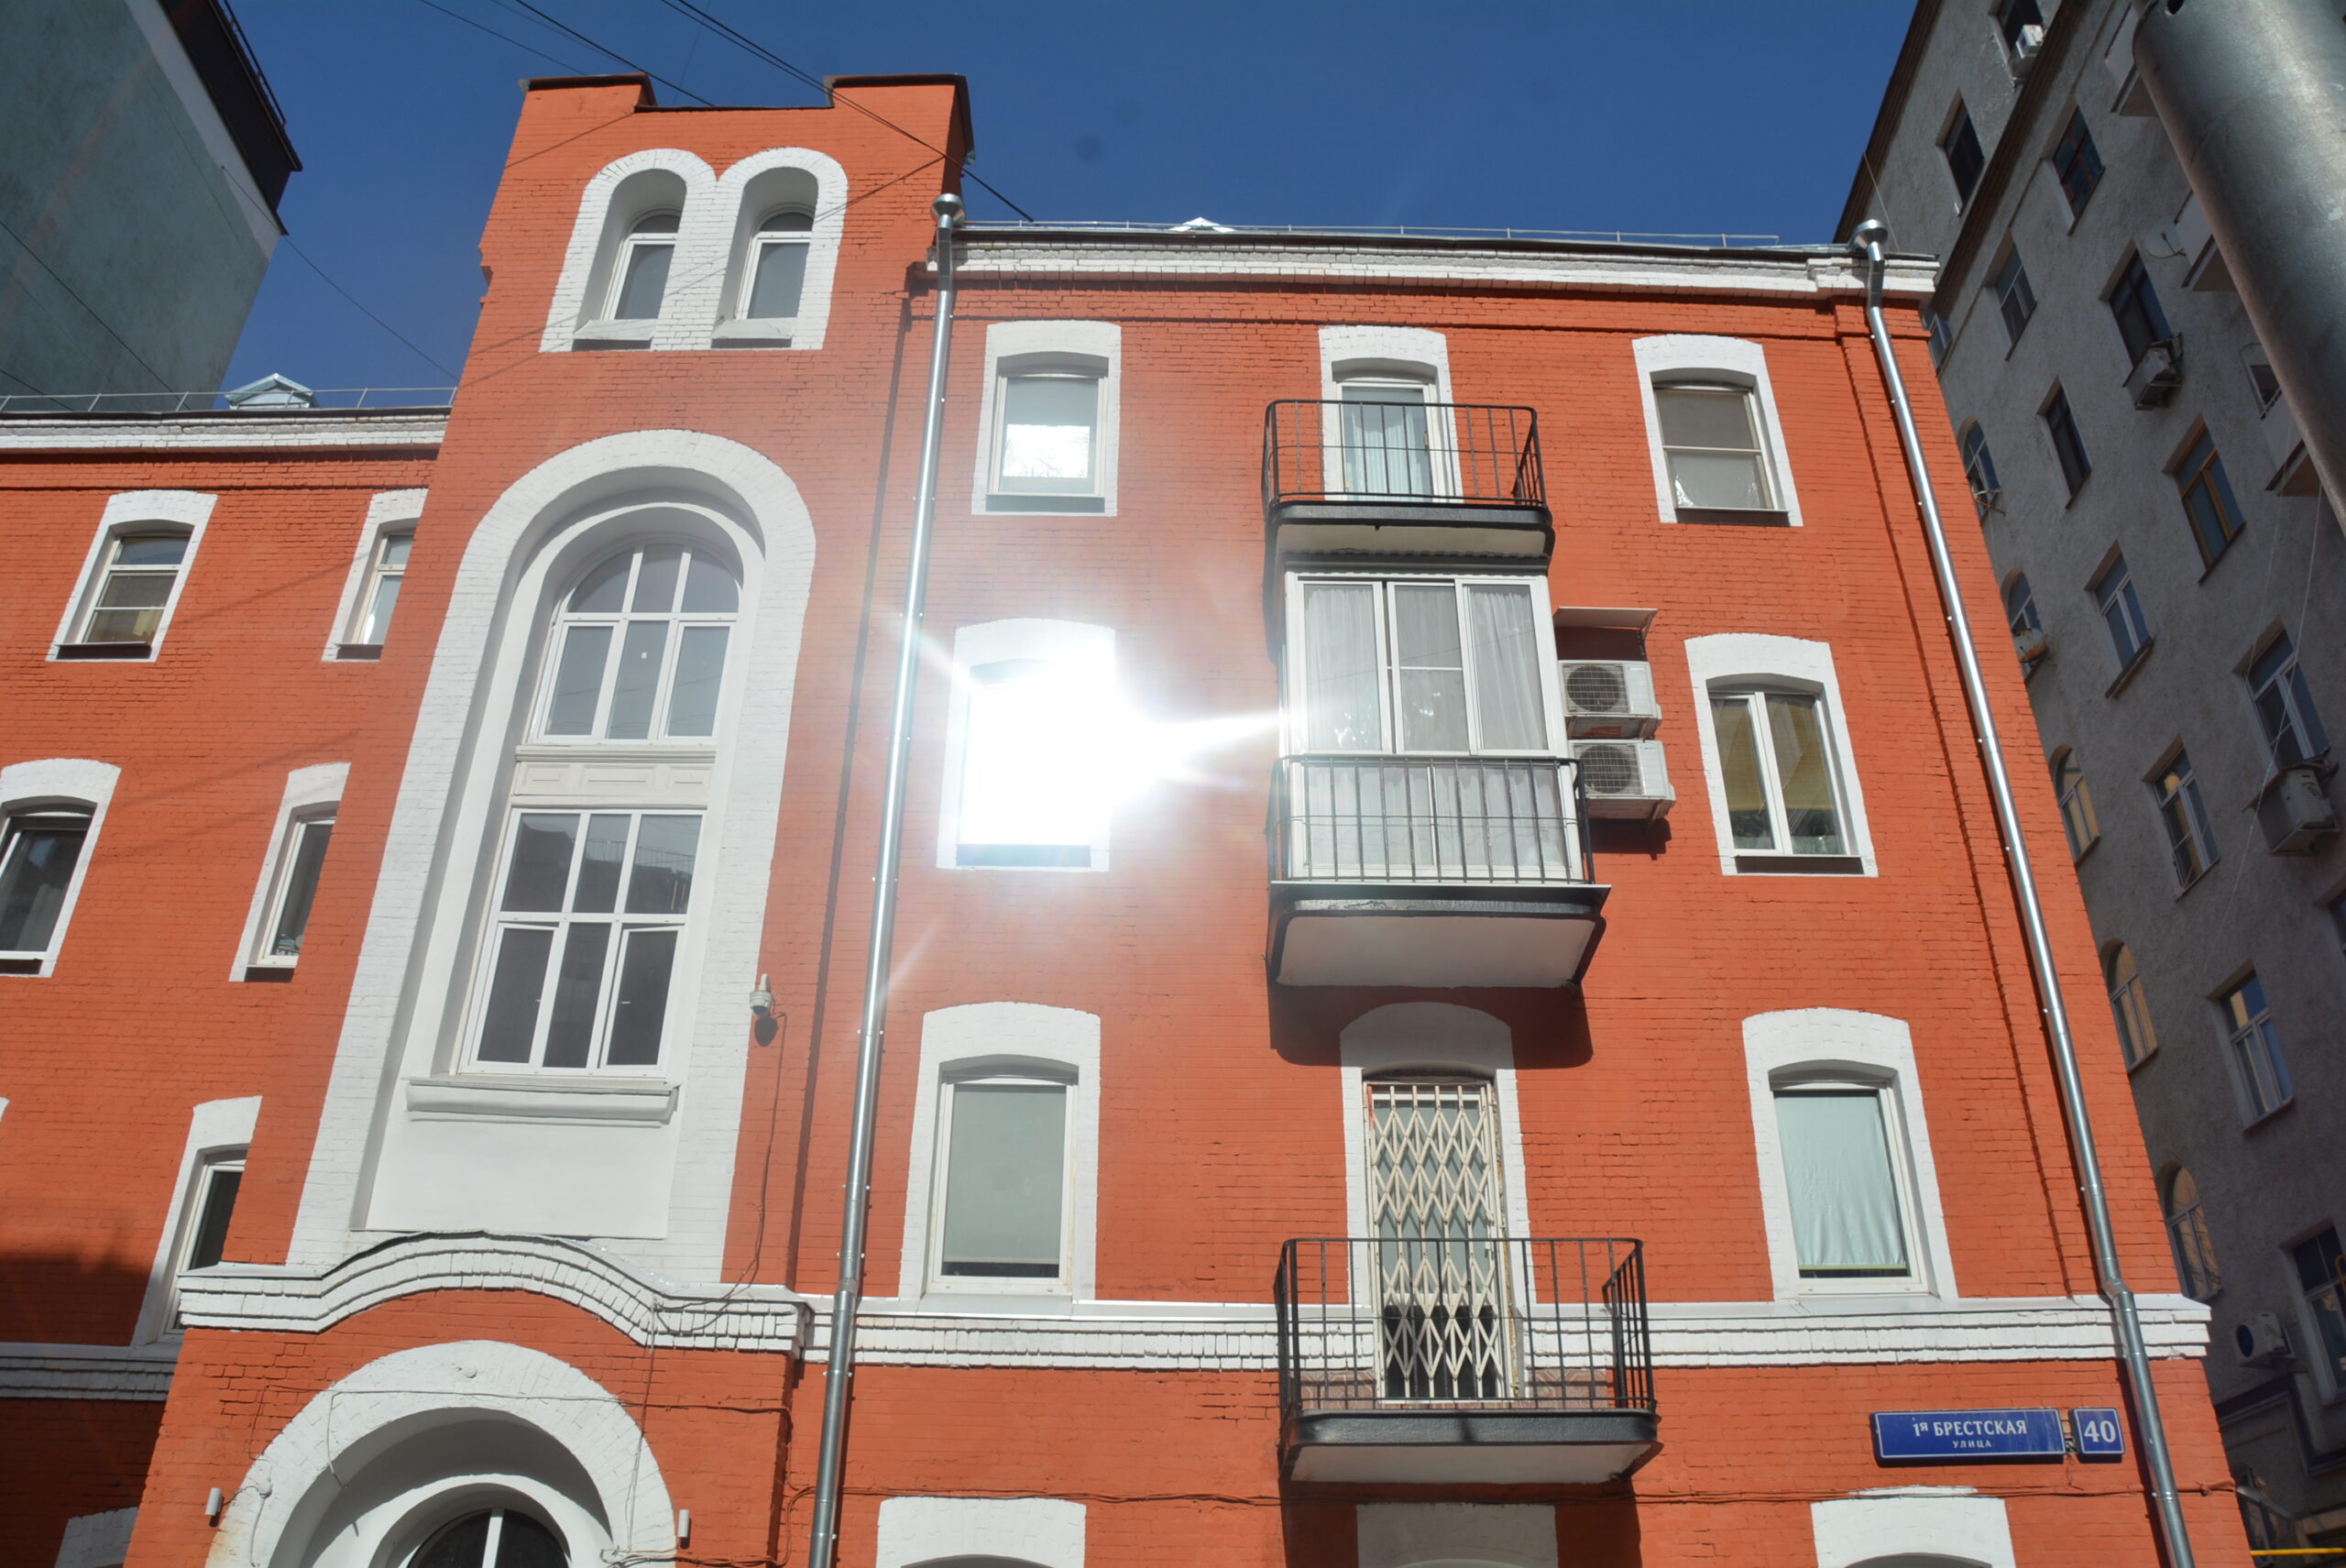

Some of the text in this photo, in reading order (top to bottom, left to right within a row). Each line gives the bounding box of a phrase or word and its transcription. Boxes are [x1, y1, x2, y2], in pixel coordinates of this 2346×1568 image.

[1933, 1420, 2027, 1436] БРЕСТСКАЯ
[2084, 1420, 2116, 1442] 40
[1953, 1440, 1991, 1449] УЛИЦА
